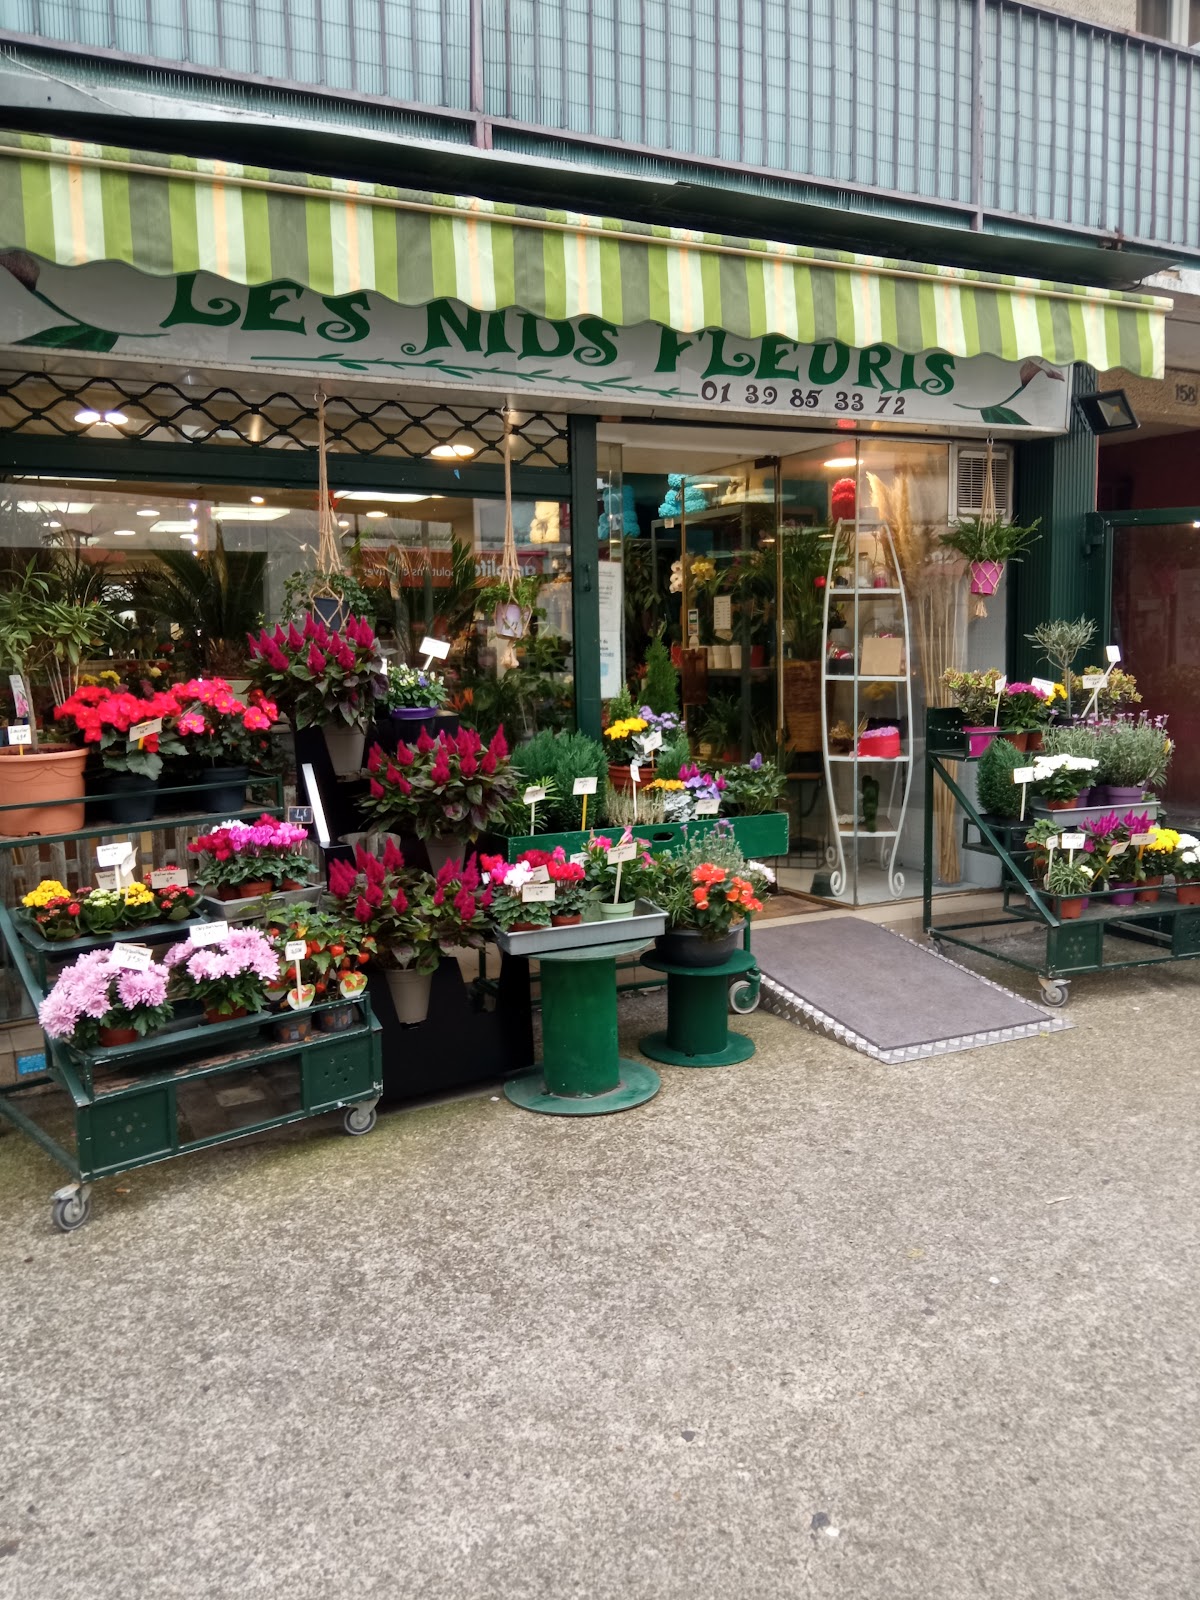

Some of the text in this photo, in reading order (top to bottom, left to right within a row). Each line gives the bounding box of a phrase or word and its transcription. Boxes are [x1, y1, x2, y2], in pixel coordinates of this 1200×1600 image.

[158, 273, 957, 397] LES NIDS FLEURIS
[701, 380, 906, 415] 01 39 85 33 72
[1175, 383, 1196, 402] 158
